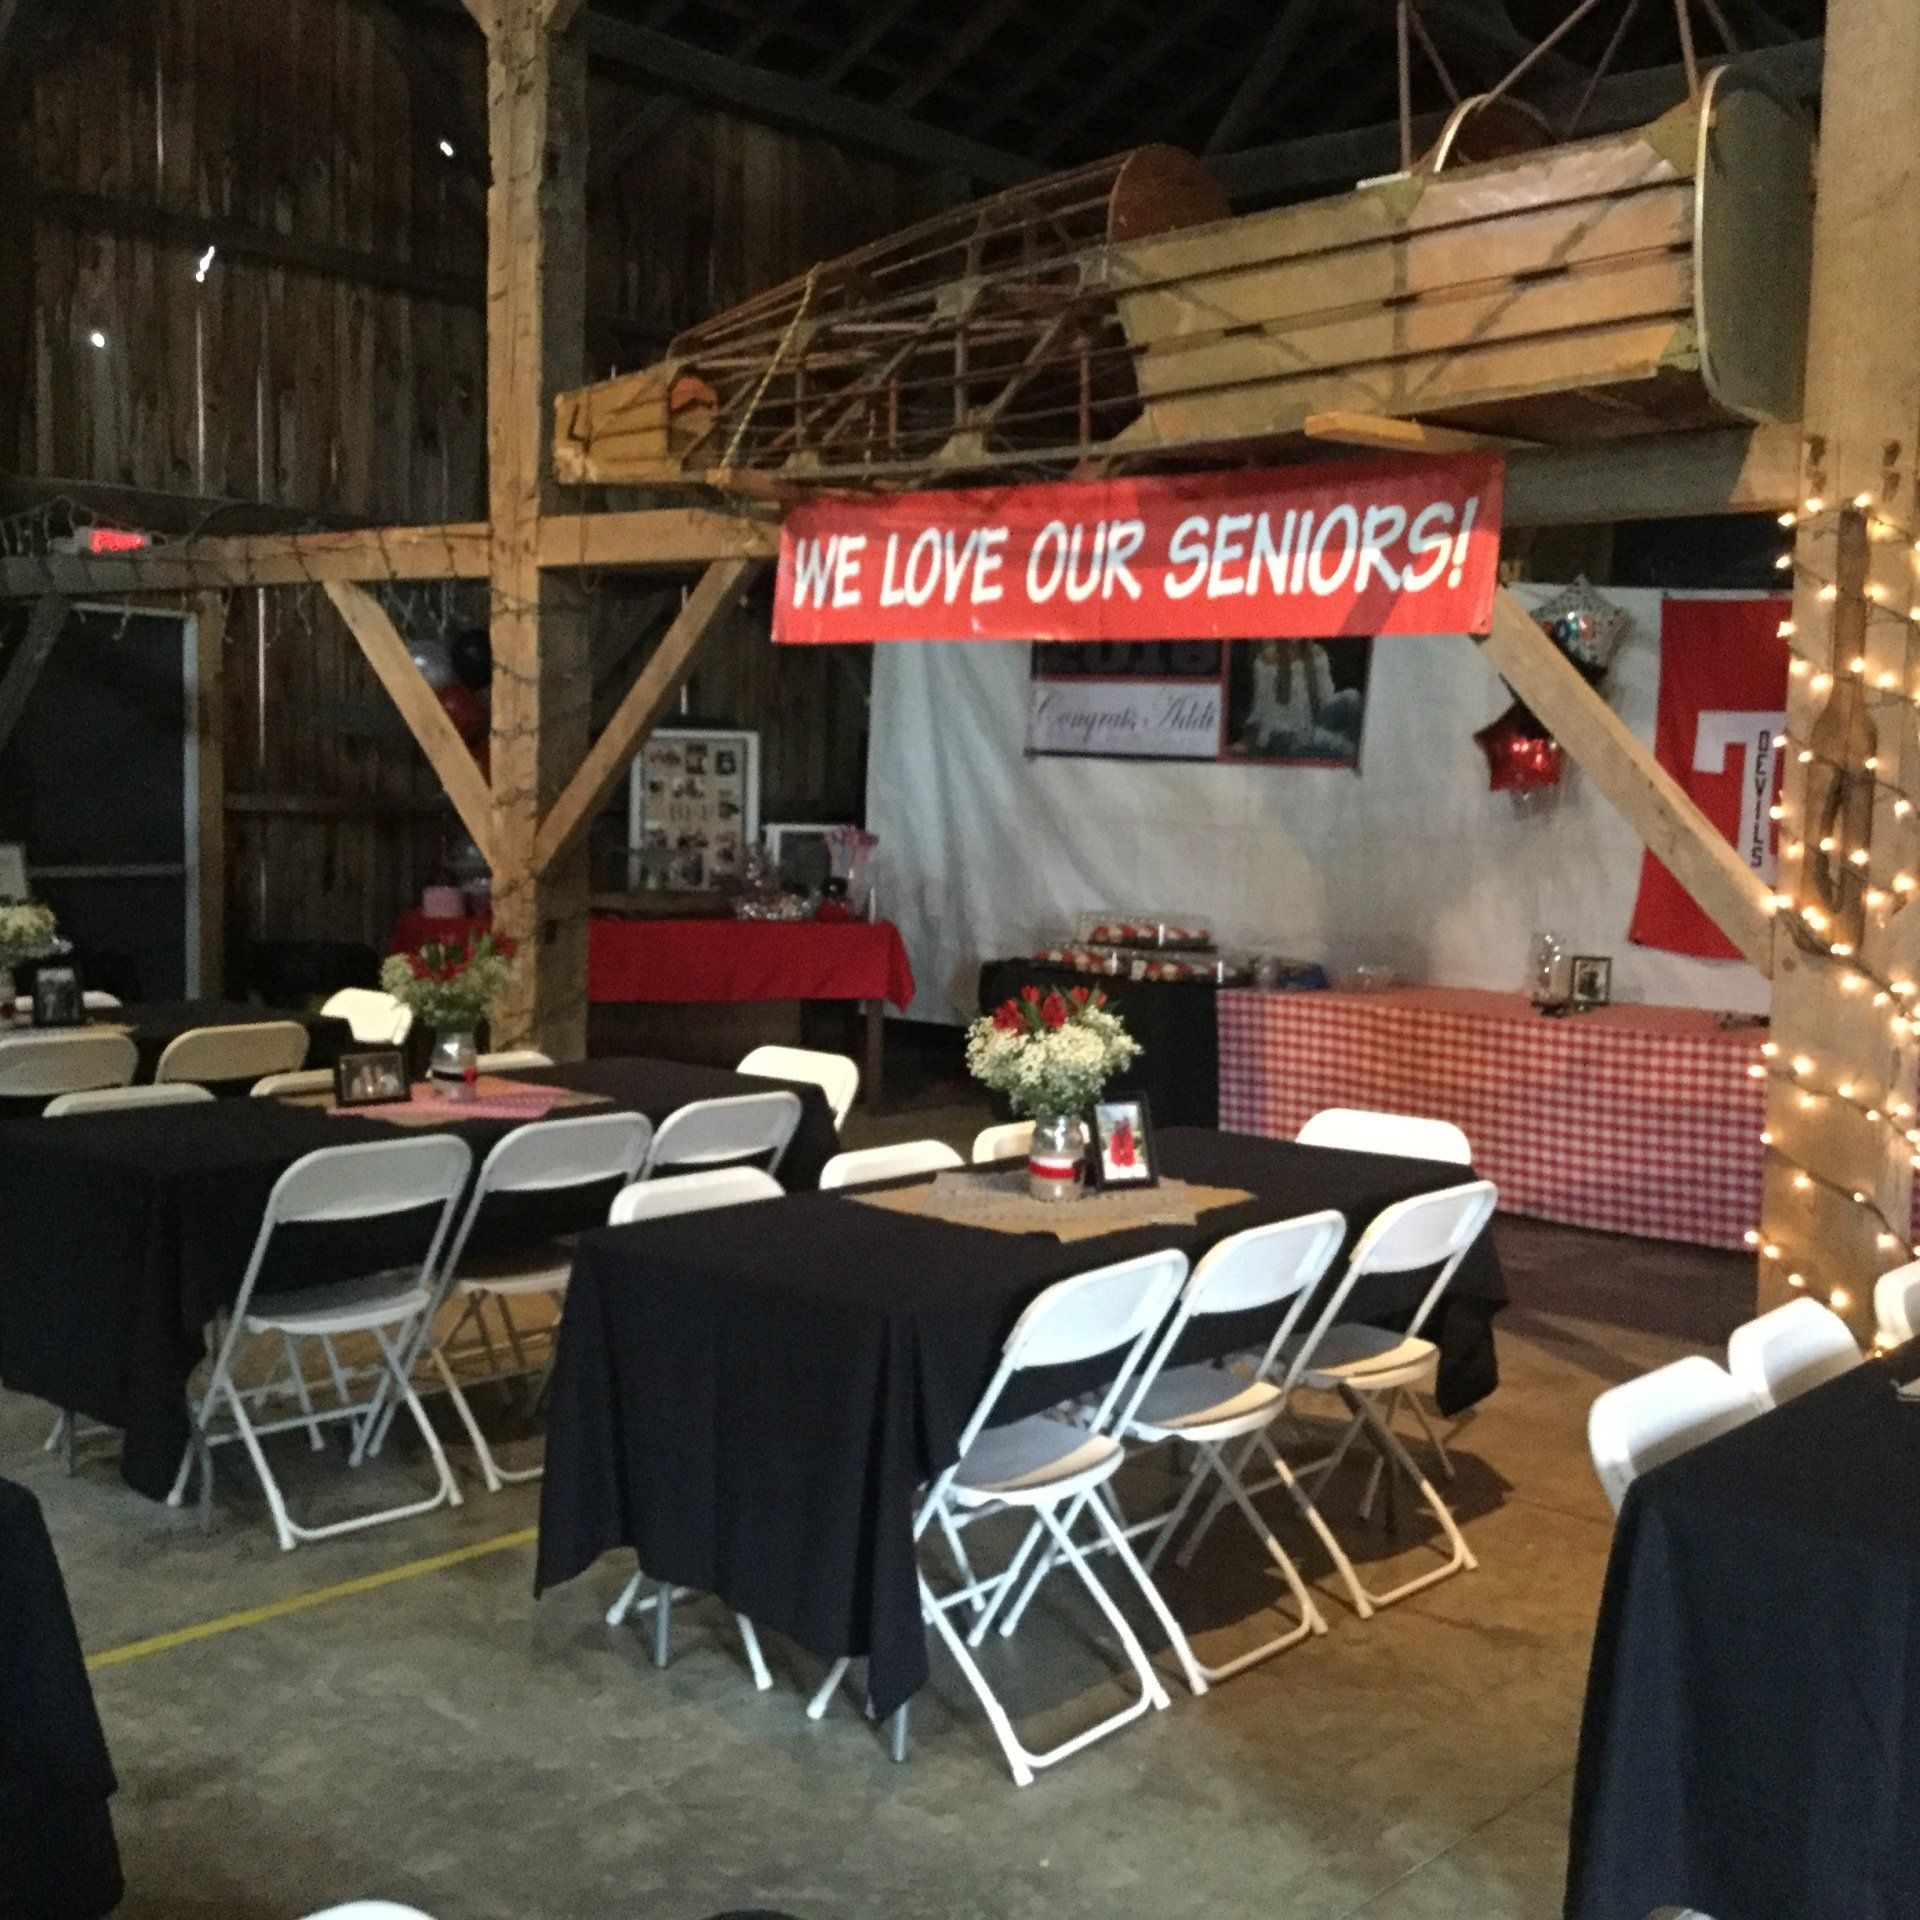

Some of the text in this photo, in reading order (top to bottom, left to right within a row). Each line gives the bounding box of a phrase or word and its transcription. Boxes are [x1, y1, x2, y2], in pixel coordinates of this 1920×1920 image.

[791, 496, 1480, 611] WE LOVE OUR SENIORS!
[1750, 729, 1771, 869] DEVILS
